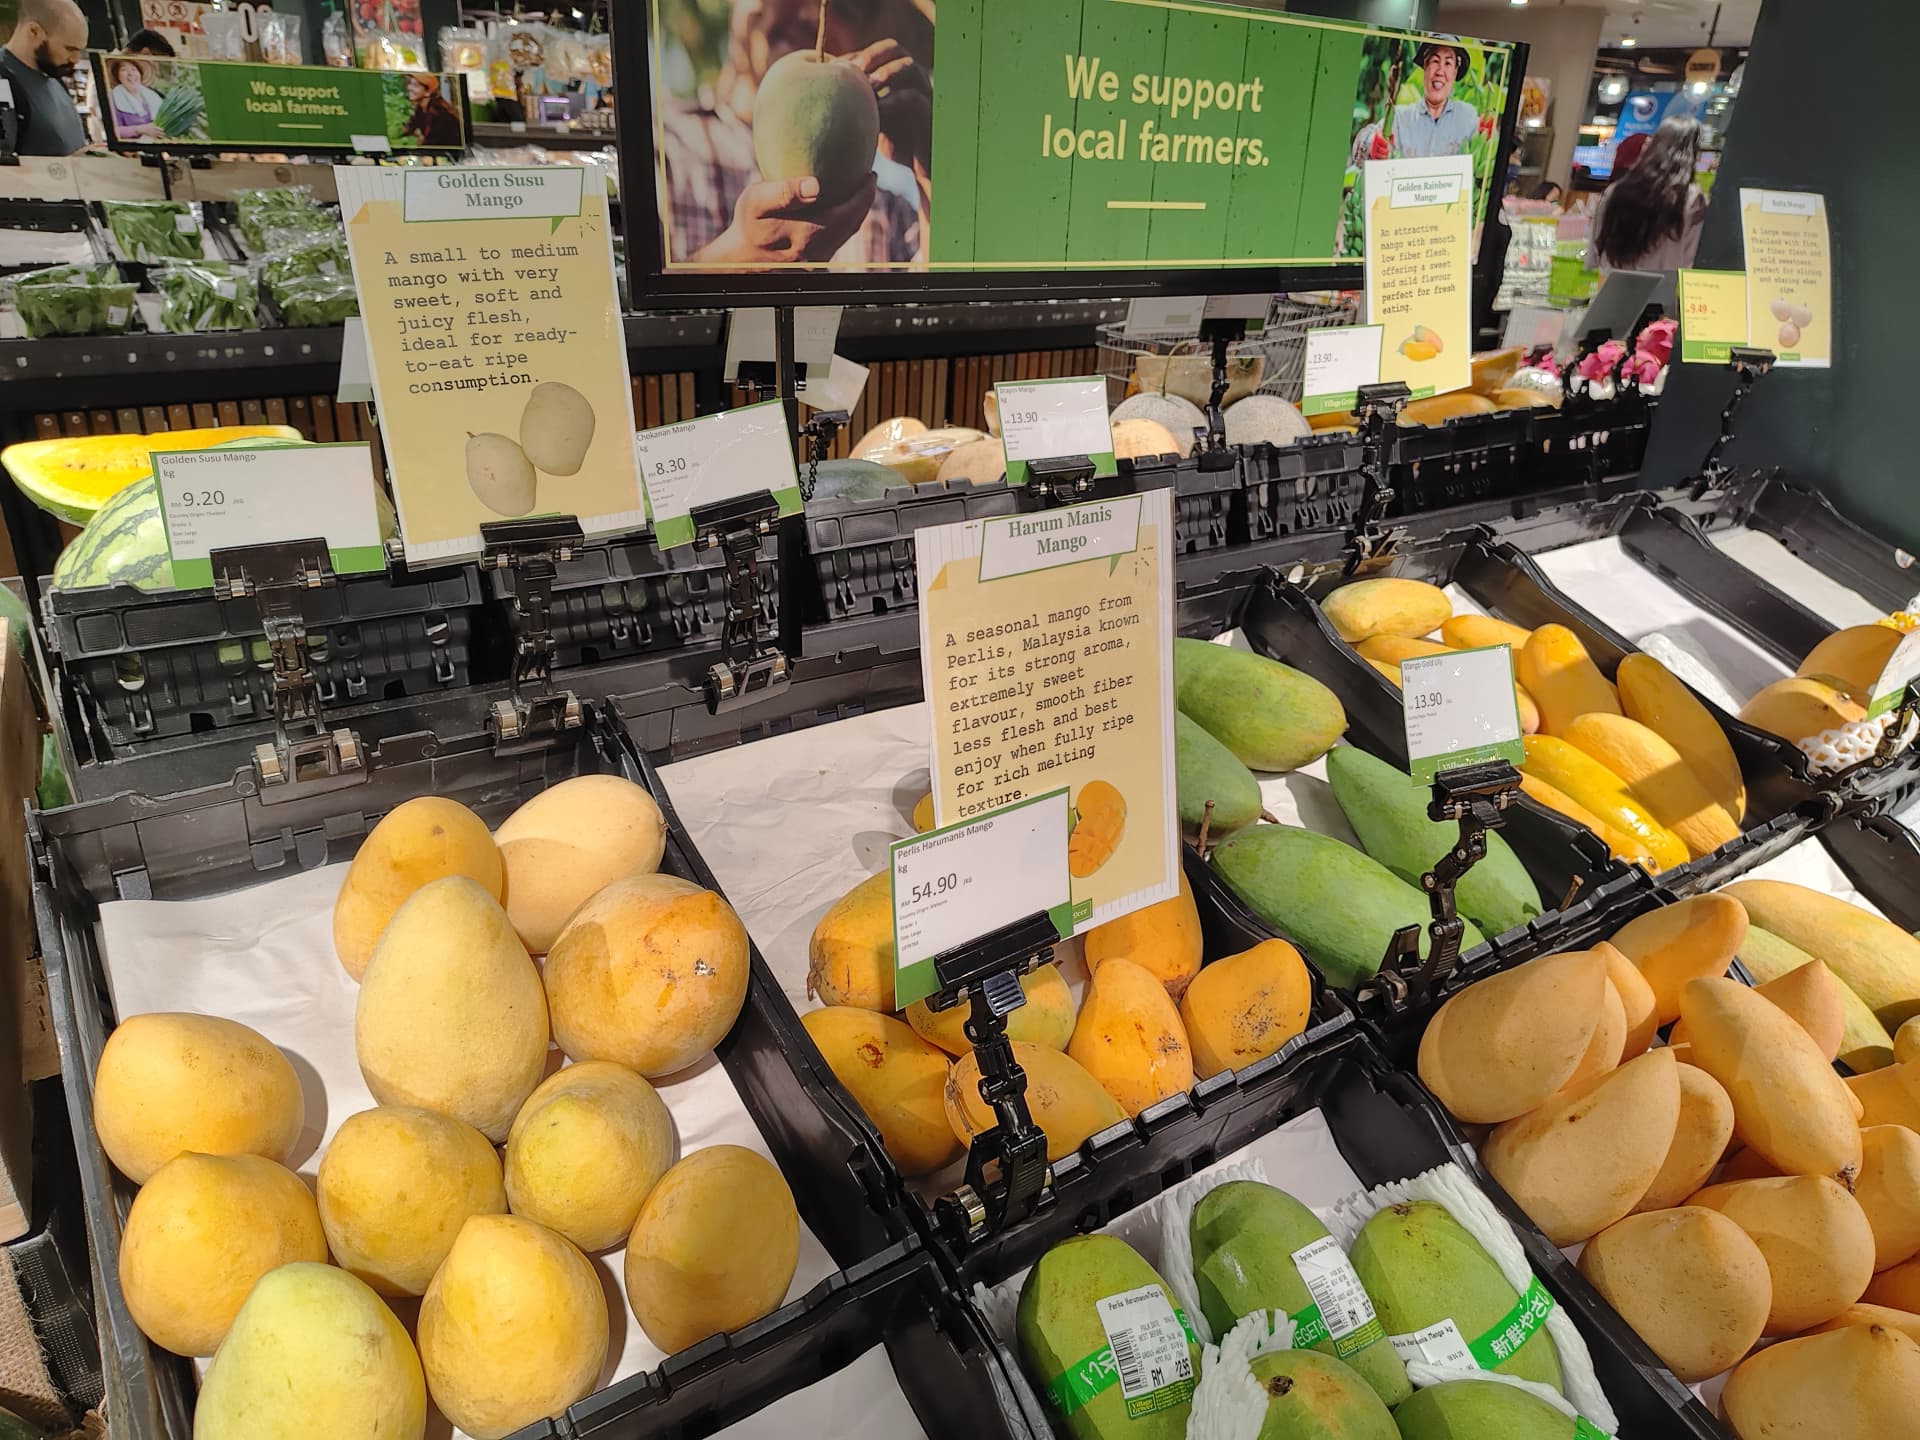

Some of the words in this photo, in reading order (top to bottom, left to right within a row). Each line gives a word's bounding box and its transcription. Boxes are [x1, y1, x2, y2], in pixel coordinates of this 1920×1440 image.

[250, 80, 275, 97] We
[279, 83, 340, 100] support
[1065, 54, 1119, 101] We
[1132, 73, 1263, 119] support
[246, 98, 283, 114] local
[286, 99, 349, 116] farmers.
[1042, 114, 1127, 160] local
[1139, 120, 1269, 166] farmers.
[438, 174, 499, 189] Golden
[503, 173, 545, 187] Susu
[1397, 182, 1422, 193] Golden
[1423, 180, 1453, 190] Rainbow
[465, 193, 523, 209] Mango
[1414, 191, 1437, 203] Mango
[1380, 228, 1390, 237] An
[1394, 224, 1438, 236] attractive
[1381, 240, 1403, 251] mango
[1407, 237, 1425, 247] with
[1429, 234, 1456, 245] smooth
[384, 251, 398, 265] A
[409, 248, 467, 263] small
[479, 247, 500, 260] to
[511, 244, 579, 259] medium
[1381, 253, 1395, 263] low
[1399, 250, 1421, 261] fiber
[388, 273, 448, 289] mango
[458, 268, 505, 283] with
[514, 267, 559, 281] very
[1381, 264, 1417, 277] offering
[1429, 260, 1452, 270] sweet
[1382, 279, 1396, 289] and
[1398, 275, 1417, 286] mild
[1421, 271, 1452, 284] flavour
[393, 293, 460, 309] sweet,
[475, 289, 519, 303] soft
[529, 286, 562, 300] and
[1382, 289, 1414, 304] perfect
[1417, 286, 1430, 296] for
[1433, 283, 1456, 294] fresh
[1382, 303, 1413, 315] eating.
[398, 315, 454, 334] juicy
[466, 310, 530, 325] flesh,
[401, 335, 458, 352] ideal
[470, 333, 502, 346] for
[514, 328, 577, 343] ready-
[405, 355, 474, 373] to-eat
[484, 352, 528, 368] ripe
[408, 372, 540, 394] consumption.
[1011, 411, 1038, 424] 13.90
[636, 428, 671, 442] Chokanan
[672, 423, 696, 436] Mango
[161, 456, 197, 465] Golden
[199, 454, 221, 463] Susu
[223, 453, 256, 464] Mango
[655, 457, 686, 475] 8.30
[163, 468, 175, 478] kg
[182, 490, 225, 507] 9.20
[1008, 516, 1063, 538] Harum
[1066, 506, 1112, 527] Manis
[1037, 535, 1088, 555] Mango
[945, 633, 957, 647] A
[966, 614, 1040, 642] seasonal
[1047, 604, 1091, 627] mango
[1098, 594, 1132, 613] from
[947, 646, 1013, 669] Perlis,
[1022, 625, 1091, 652] Malaysia
[1099, 613, 1140, 633] known
[949, 673, 978, 691] for
[988, 664, 1015, 680] its
[1024, 651, 1075, 673] strong
[1083, 636, 1131, 657] aroma,
[1403, 661, 1420, 672] Mango
[1421, 659, 1434, 669] Gold
[949, 681, 1034, 713] extremely
[1043, 667, 1085, 688] sweet
[1414, 691, 1443, 709] 13.90
[952, 708, 1025, 735] flavour,
[1035, 687, 1085, 711] smooth
[1093, 674, 1134, 695] fiber
[953, 737, 992, 756] less
[1001, 720, 1045, 743] flesh
[1053, 708, 1078, 727] and
[1084, 697, 1118, 718] best
[954, 754, 1001, 777] enjoy
[1010, 739, 1046, 760] when
[1053, 723, 1094, 748] fully
[1102, 713, 1135, 733] ripe
[956, 781, 985, 798] for
[993, 767, 1030, 787] rich
[1037, 746, 1096, 772] melting
[957, 788, 1028, 818] texture.
[897, 845, 920, 860] Perlis
[922, 832, 965, 852] Harumanis
[966, 820, 994, 837] Mango
[897, 864, 908, 874] kg
[912, 872, 957, 904] 54.90
